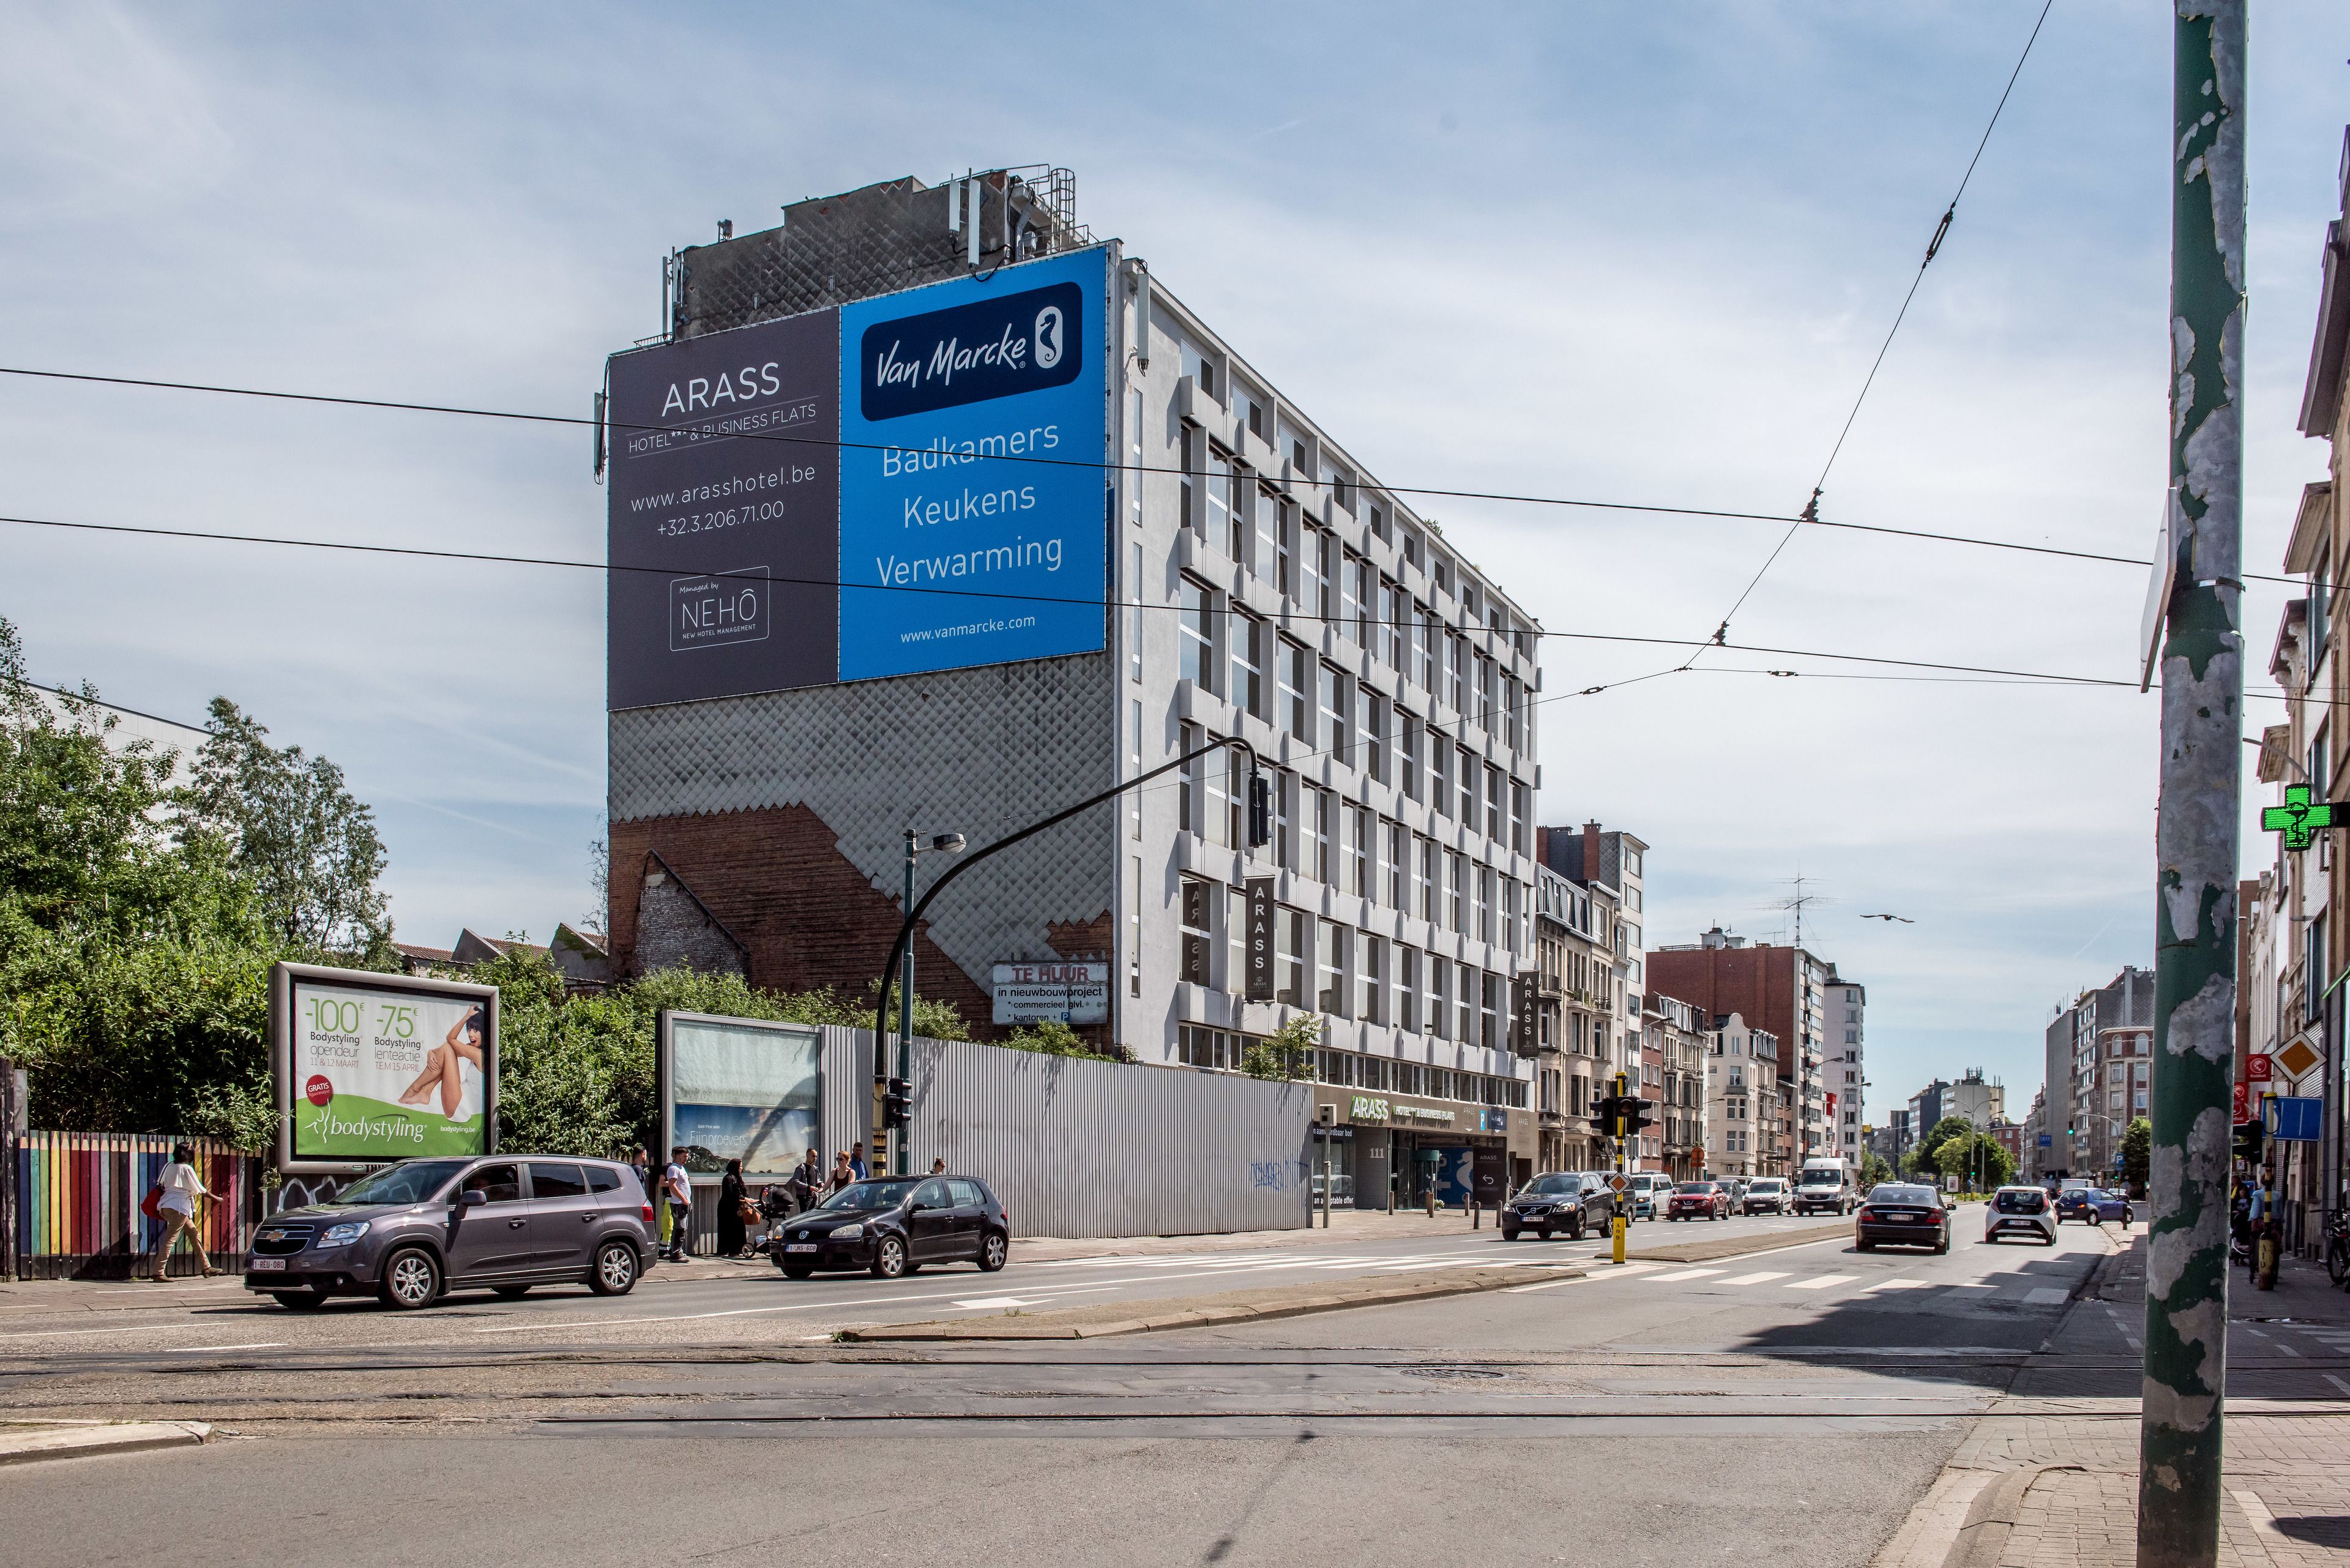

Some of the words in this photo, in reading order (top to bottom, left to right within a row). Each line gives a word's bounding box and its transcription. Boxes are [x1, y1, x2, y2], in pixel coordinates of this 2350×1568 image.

[877, 340, 920, 388] Van
[926, 323, 1026, 386] Marcke
[662, 362, 780, 417] ARASS
[690, 428, 699, 441] &
[703, 413, 768, 438] BUSINESS
[772, 403, 816, 425] FLATS
[883, 425, 1059, 477] Badkamers
[631, 465, 815, 512] www.arasshotel.be
[905, 486, 1036, 529] Keukens
[657, 501, 785, 536] +32.3.206.71.00
[876, 536, 1062, 586] Verwarming
[679, 584, 707, 594] Managed
[707, 582, 719, 591] by
[682, 589, 757, 629] NEHÔ
[717, 623, 756, 635] MANAGEMENT
[900, 616, 1036, 643] www.vanmarcke.com
[1255, 886, 1265, 968] ARASS
[1012, 967, 1034, 982] TE
[1039, 966, 1090, 982] HUUR
[998, 987, 1007, 996] in
[1010, 987, 1102, 998] nieuwbouwproject
[310, 1031, 360, 1046] Bodystyling
[375, 1037, 421, 1050] Bodystyling
[310, 1044, 360, 1059] opendeur
[375, 1047, 420, 1062] lenteactie
[310, 1057, 318, 1066] 11
[319, 1058, 326, 1066] &
[393, 1062, 401, 1071] 15
[402, 1064, 420, 1072] APRIL
[308, 1082, 329, 1092] GRATIS
[1352, 1096, 1389, 1121] ARASS
[1420, 1108, 1441, 1119] BUSINESS
[1442, 1111, 1455, 1121] FLATS
[330, 1115, 424, 1143] bodystyling
[1370, 1148, 1384, 1159] 111
[1321, 1197, 1343, 1206] aptable
